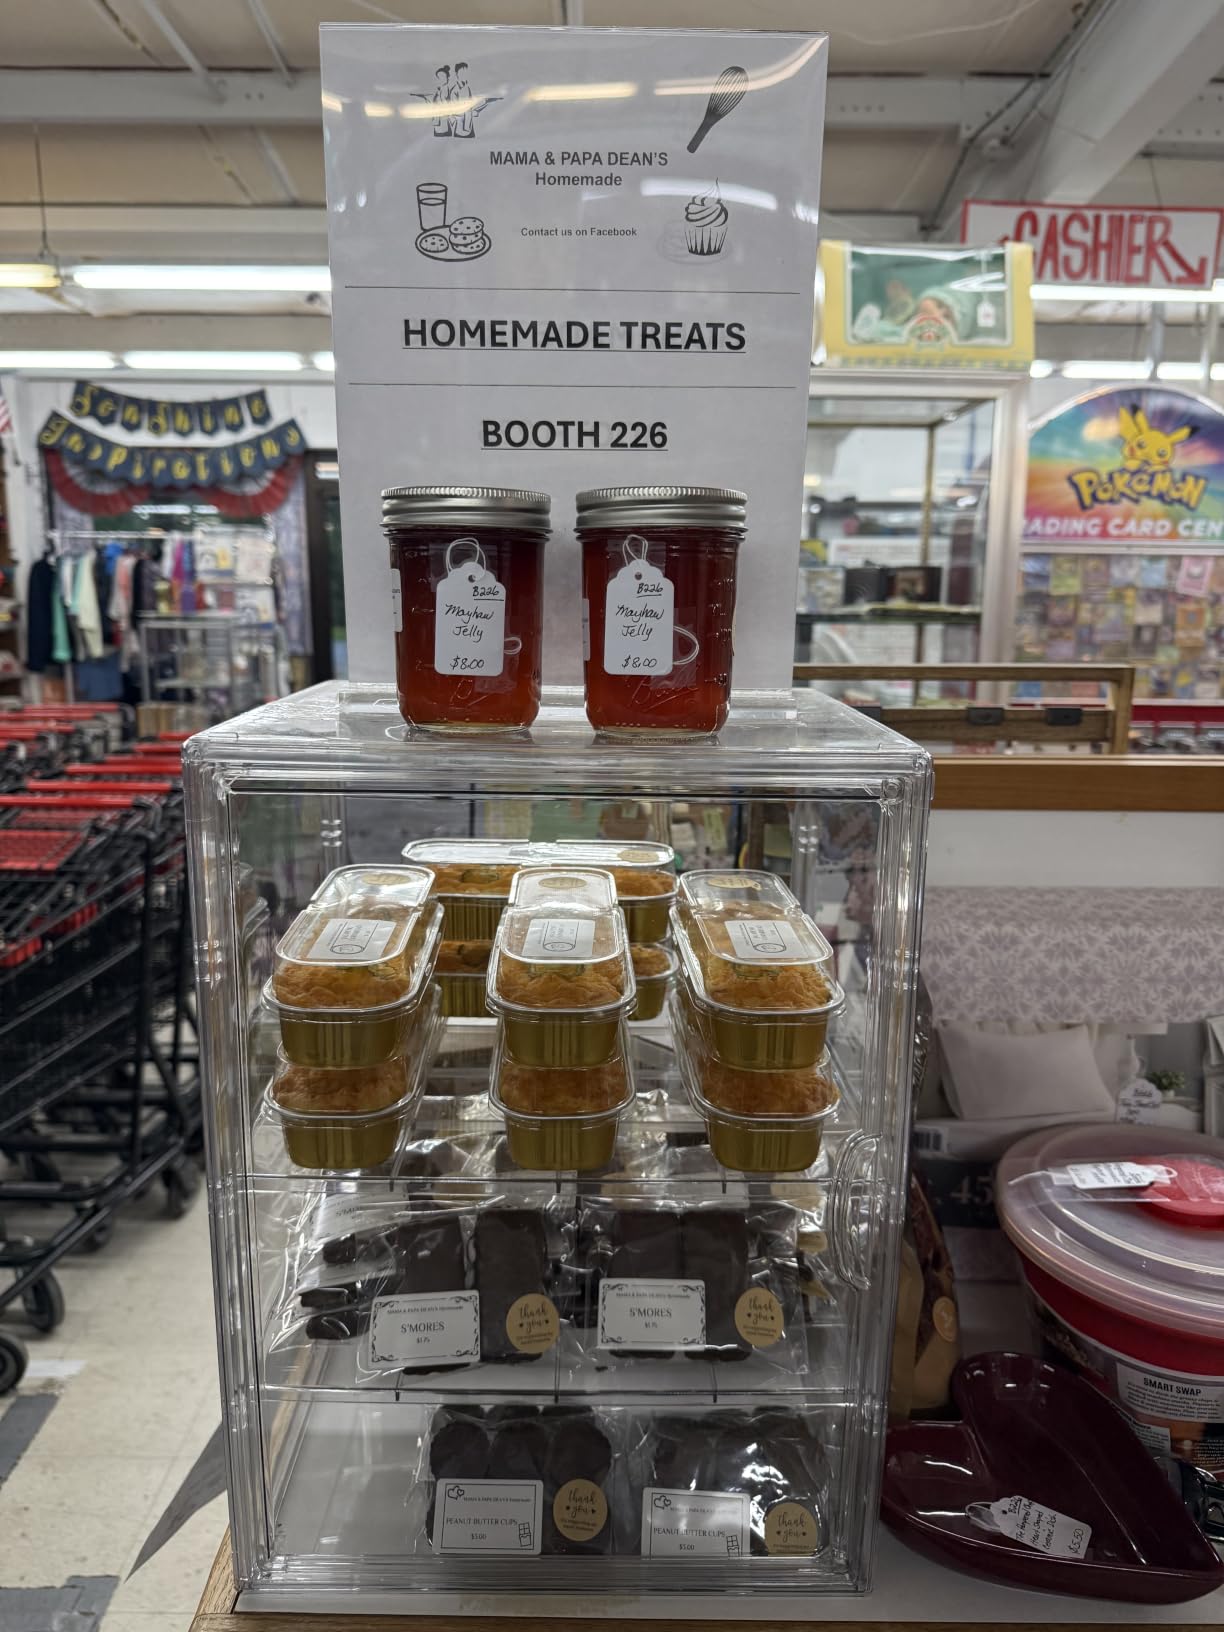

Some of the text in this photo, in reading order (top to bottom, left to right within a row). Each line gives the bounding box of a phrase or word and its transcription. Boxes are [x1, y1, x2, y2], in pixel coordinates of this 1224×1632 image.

[490, 151, 668, 166] MAMA & PAPA DEAN'S
[535, 172, 622, 186] Homemade
[520, 227, 637, 237] Contact us on Facebook
[1012, 208, 1173, 284] CASHIER
[403, 319, 747, 351] HOMEMADE TREATS
[482, 420, 668, 449] BOOTH 226
[1107, 517, 1171, 537] CARD
[472, 585, 500, 598] B226
[637, 582, 664, 594] B226
[452, 624, 483, 643] Jelly
[621, 622, 653, 642] Jelly
[450, 654, 485, 670] $8.00
[622, 655, 658, 669] $8.00
[629, 1307, 672, 1318] S'MORES
[400, 1320, 445, 1334] S'MORES
[1143, 1377, 1202, 1396] SMART SWAP
